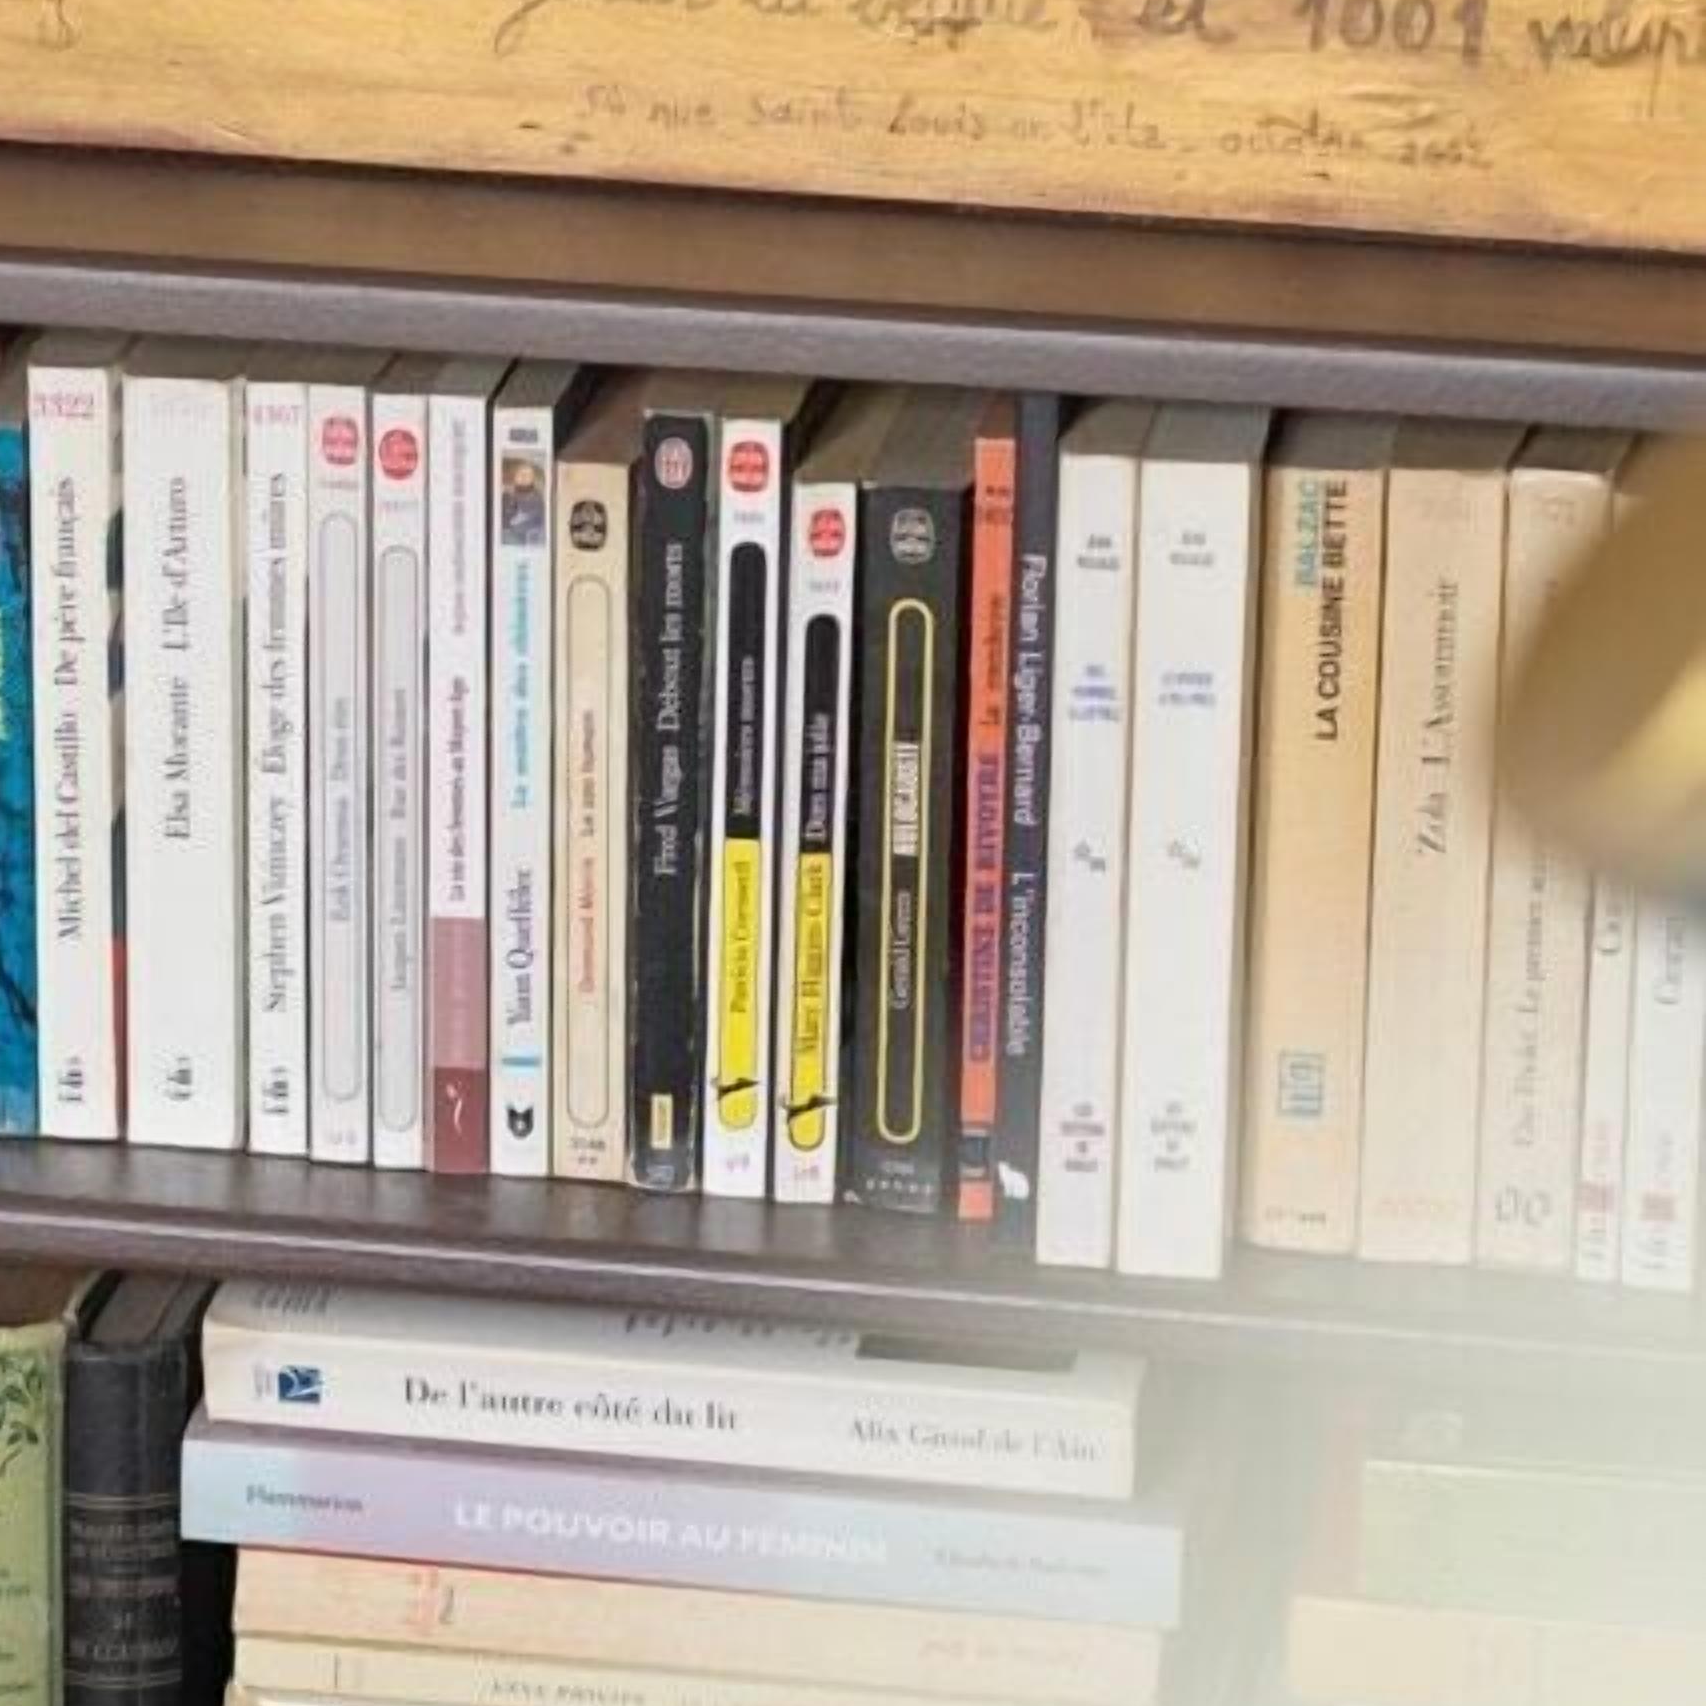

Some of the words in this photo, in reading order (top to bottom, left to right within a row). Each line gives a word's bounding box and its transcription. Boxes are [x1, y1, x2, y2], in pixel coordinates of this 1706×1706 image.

[1320, 480, 1349, 570] BETTE
[1317, 577, 1346, 700] COUSINE
[1314, 706, 1340, 742] LA
[403, 1374, 441, 1406] De
[459, 1379, 565, 1419] l'autre
[573, 1388, 641, 1422] côté
[653, 1396, 695, 1426] du
[453, 1499, 491, 1527] LE
[503, 1503, 671, 1545] POUVOIR
[681, 1524, 730, 1551] AU
